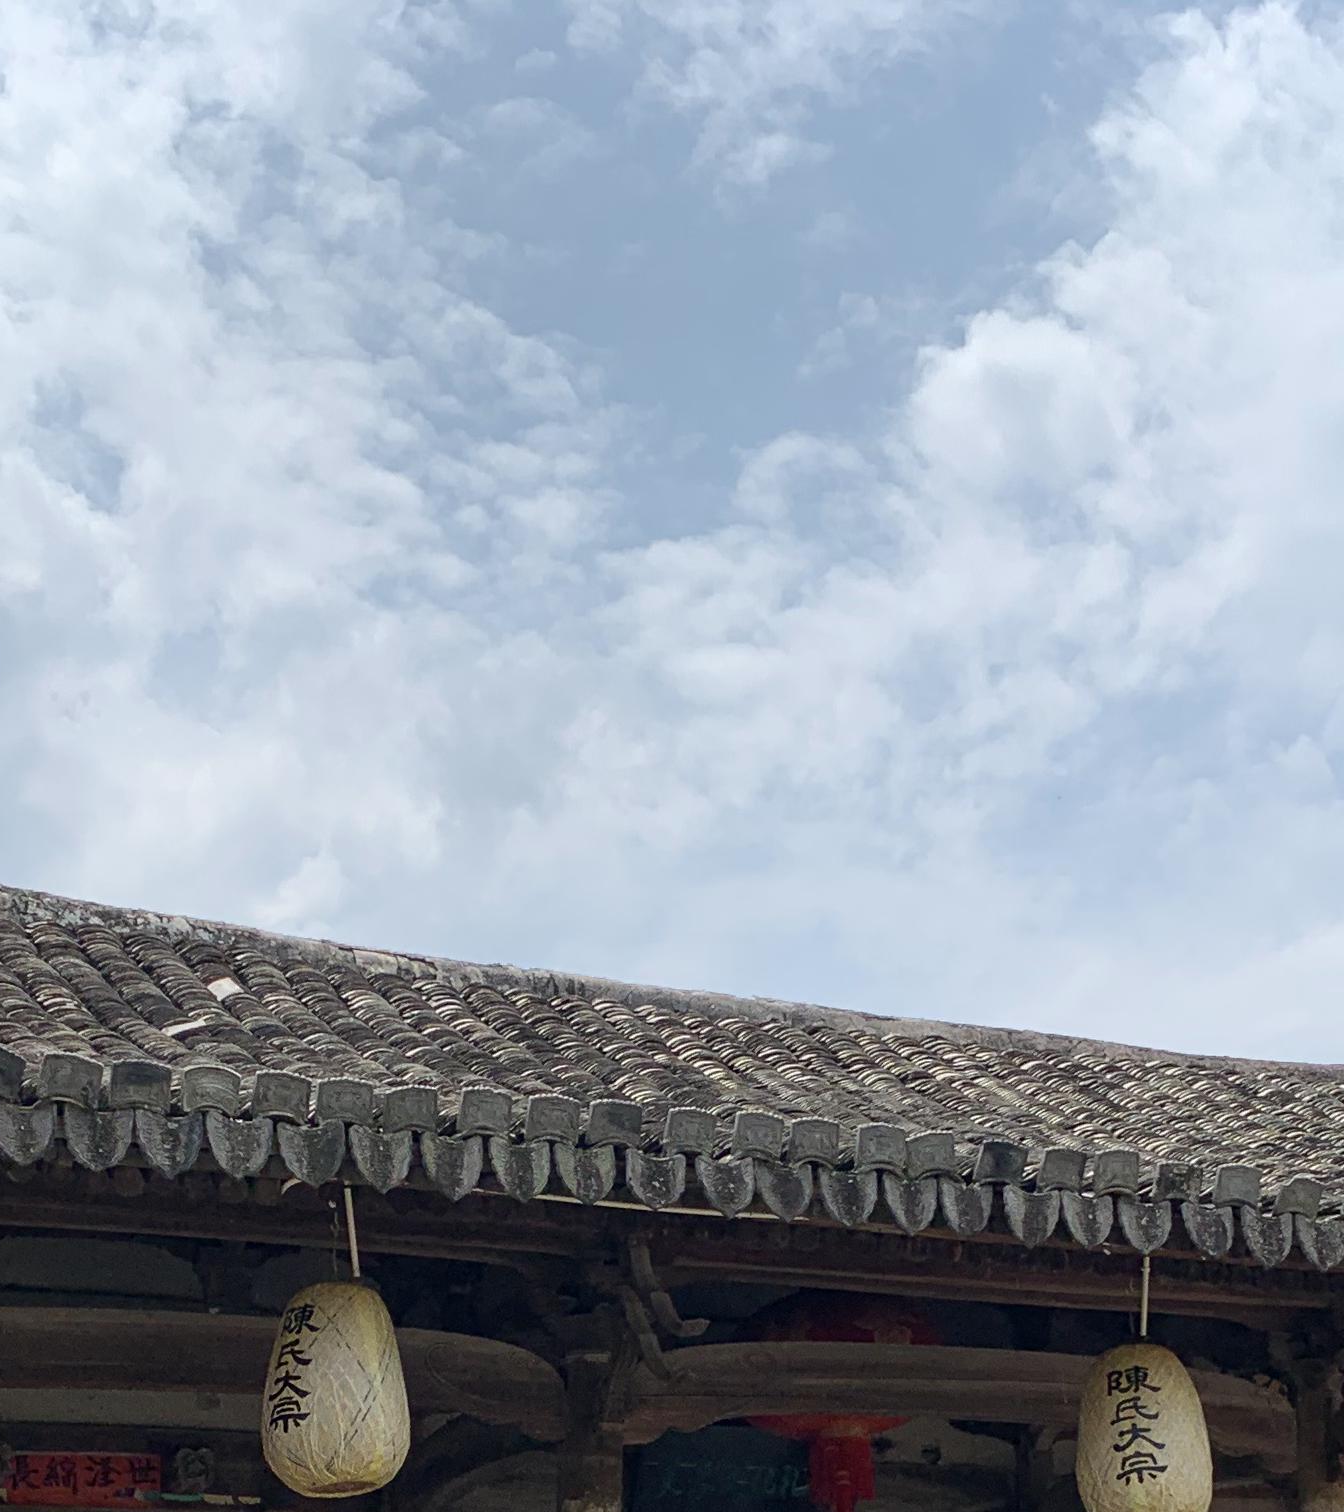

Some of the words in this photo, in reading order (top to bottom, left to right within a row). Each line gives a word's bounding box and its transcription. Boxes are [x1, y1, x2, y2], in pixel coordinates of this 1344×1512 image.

[269, 1303, 320, 1433] 陳氏大宗
[1106, 1368, 1168, 1485] 陳氏大宗
